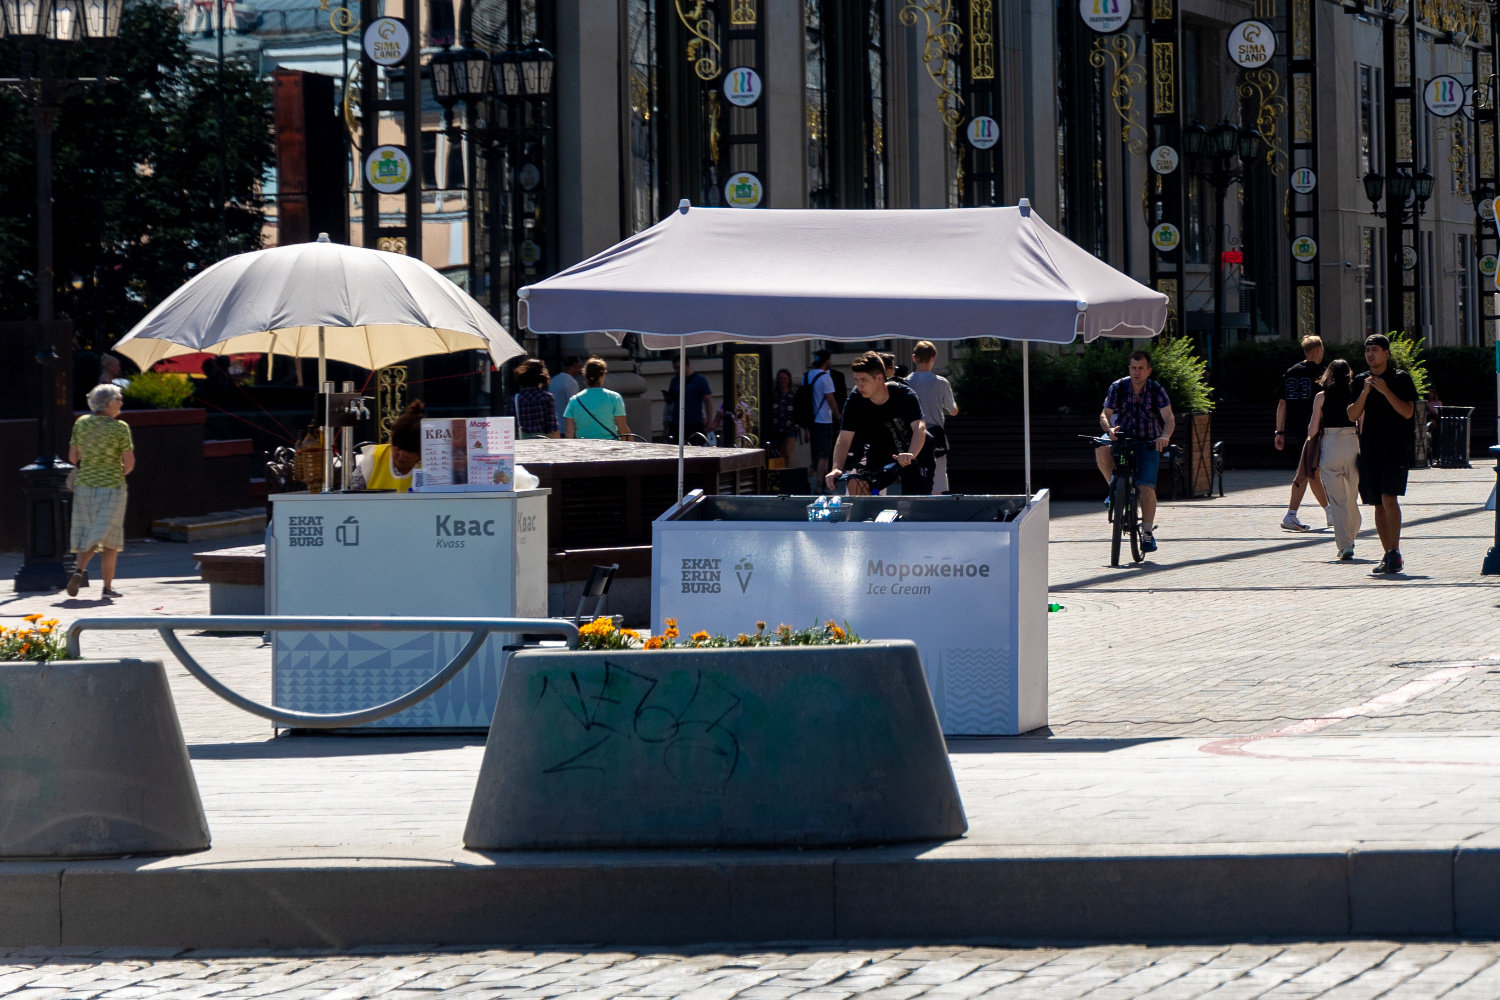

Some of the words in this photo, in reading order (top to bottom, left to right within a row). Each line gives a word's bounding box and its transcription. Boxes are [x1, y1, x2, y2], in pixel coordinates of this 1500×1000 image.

[373, 41, 401, 51] SIMA
[1237, 44, 1267, 54] SIMA
[373, 50, 401, 60] LAND
[1238, 53, 1268, 64] LAND
[1285, 377, 1312, 400] 23
[469, 420, 491, 430] Морс
[425, 428, 457, 440] КВА
[288, 516, 324, 526] EKAT
[435, 514, 495, 537] Квас
[517, 511, 537, 533] Квас
[288, 526, 324, 537] ERIN
[288, 537, 324, 547] BURG
[435, 538, 466, 549] Kvass
[681, 558, 722, 570] EKAT
[681, 570, 722, 582] ERIN
[866, 559, 990, 582] Мороженое
[681, 581, 722, 594] BURG
[866, 582, 888, 596] Ice
[893, 582, 931, 596] Cream
